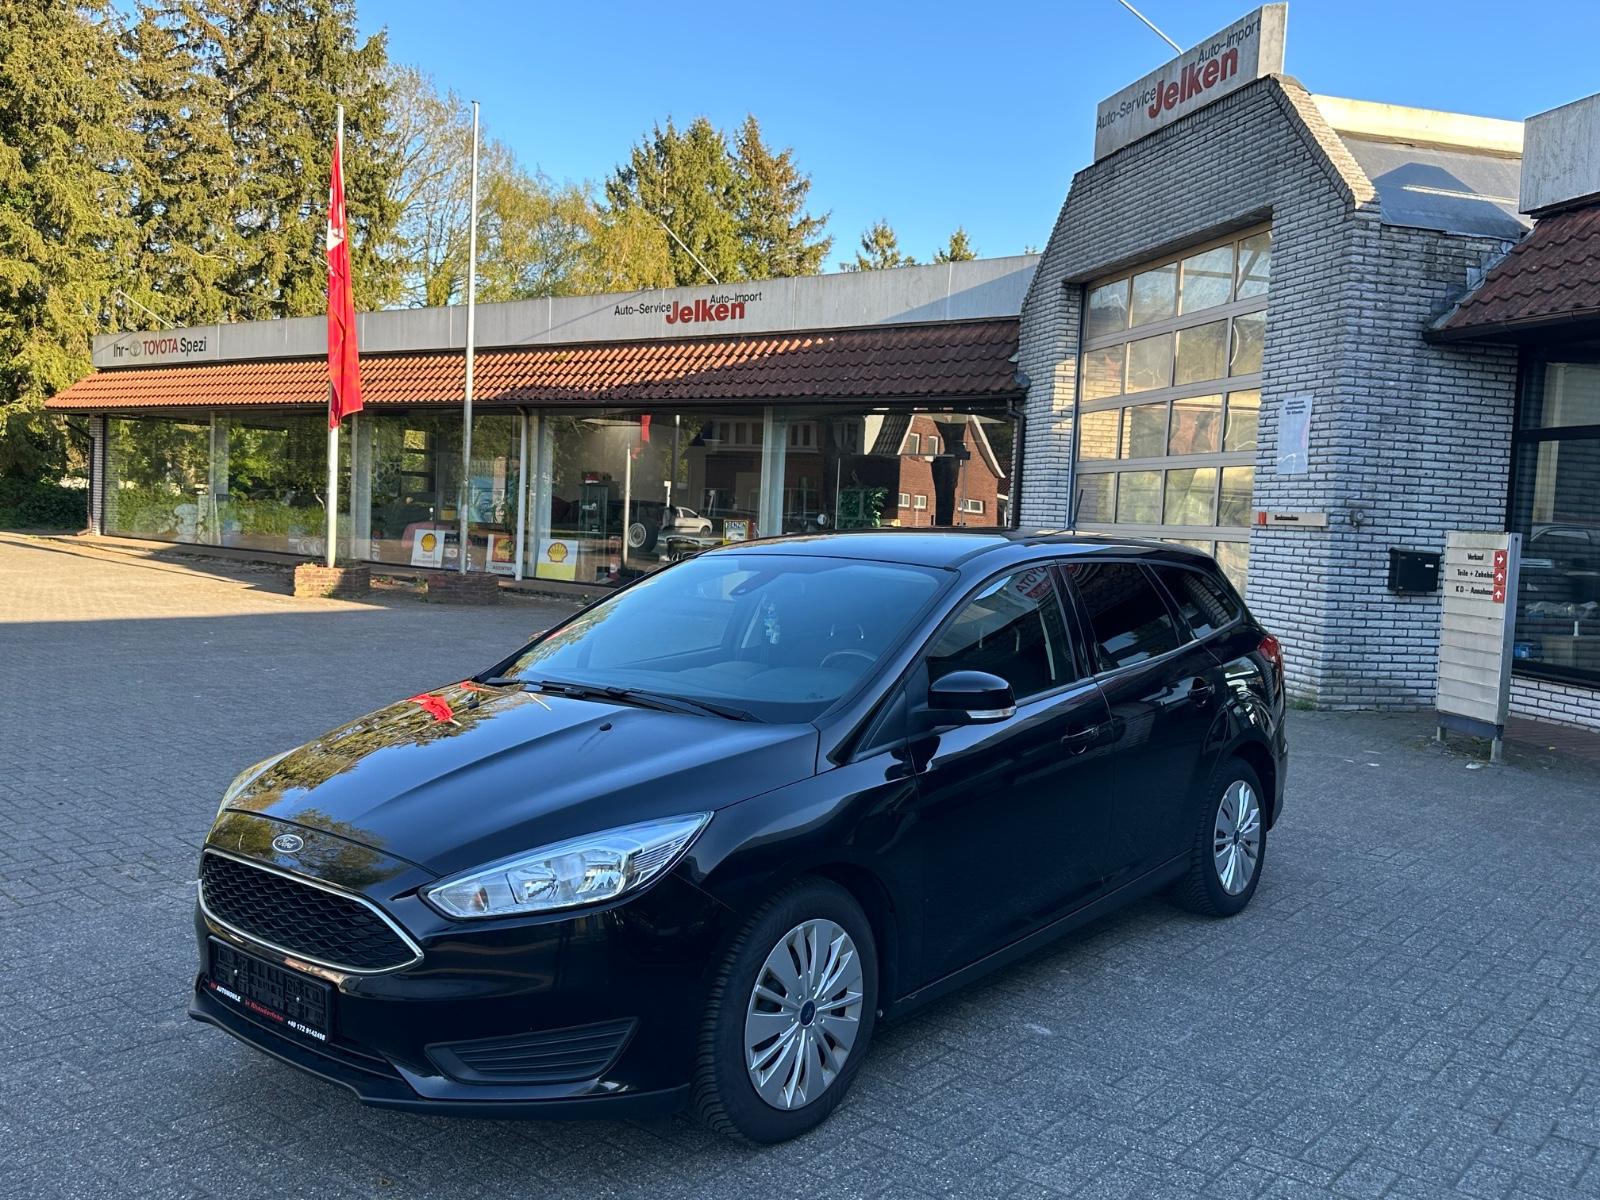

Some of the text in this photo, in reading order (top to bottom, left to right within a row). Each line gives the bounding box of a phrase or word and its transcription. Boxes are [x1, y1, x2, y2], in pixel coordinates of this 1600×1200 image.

[1198, 17, 1261, 65] Auto-Import
[1148, 47, 1238, 119] Jelken
[1097, 87, 1156, 129] Auto-Service
[614, 302, 671, 316] Auto-Service
[710, 291, 762, 304] Auto-Import
[666, 299, 745, 324] Jelken
[142, 338, 178, 356] TOYOTA
[180, 336, 207, 356] Spezi
